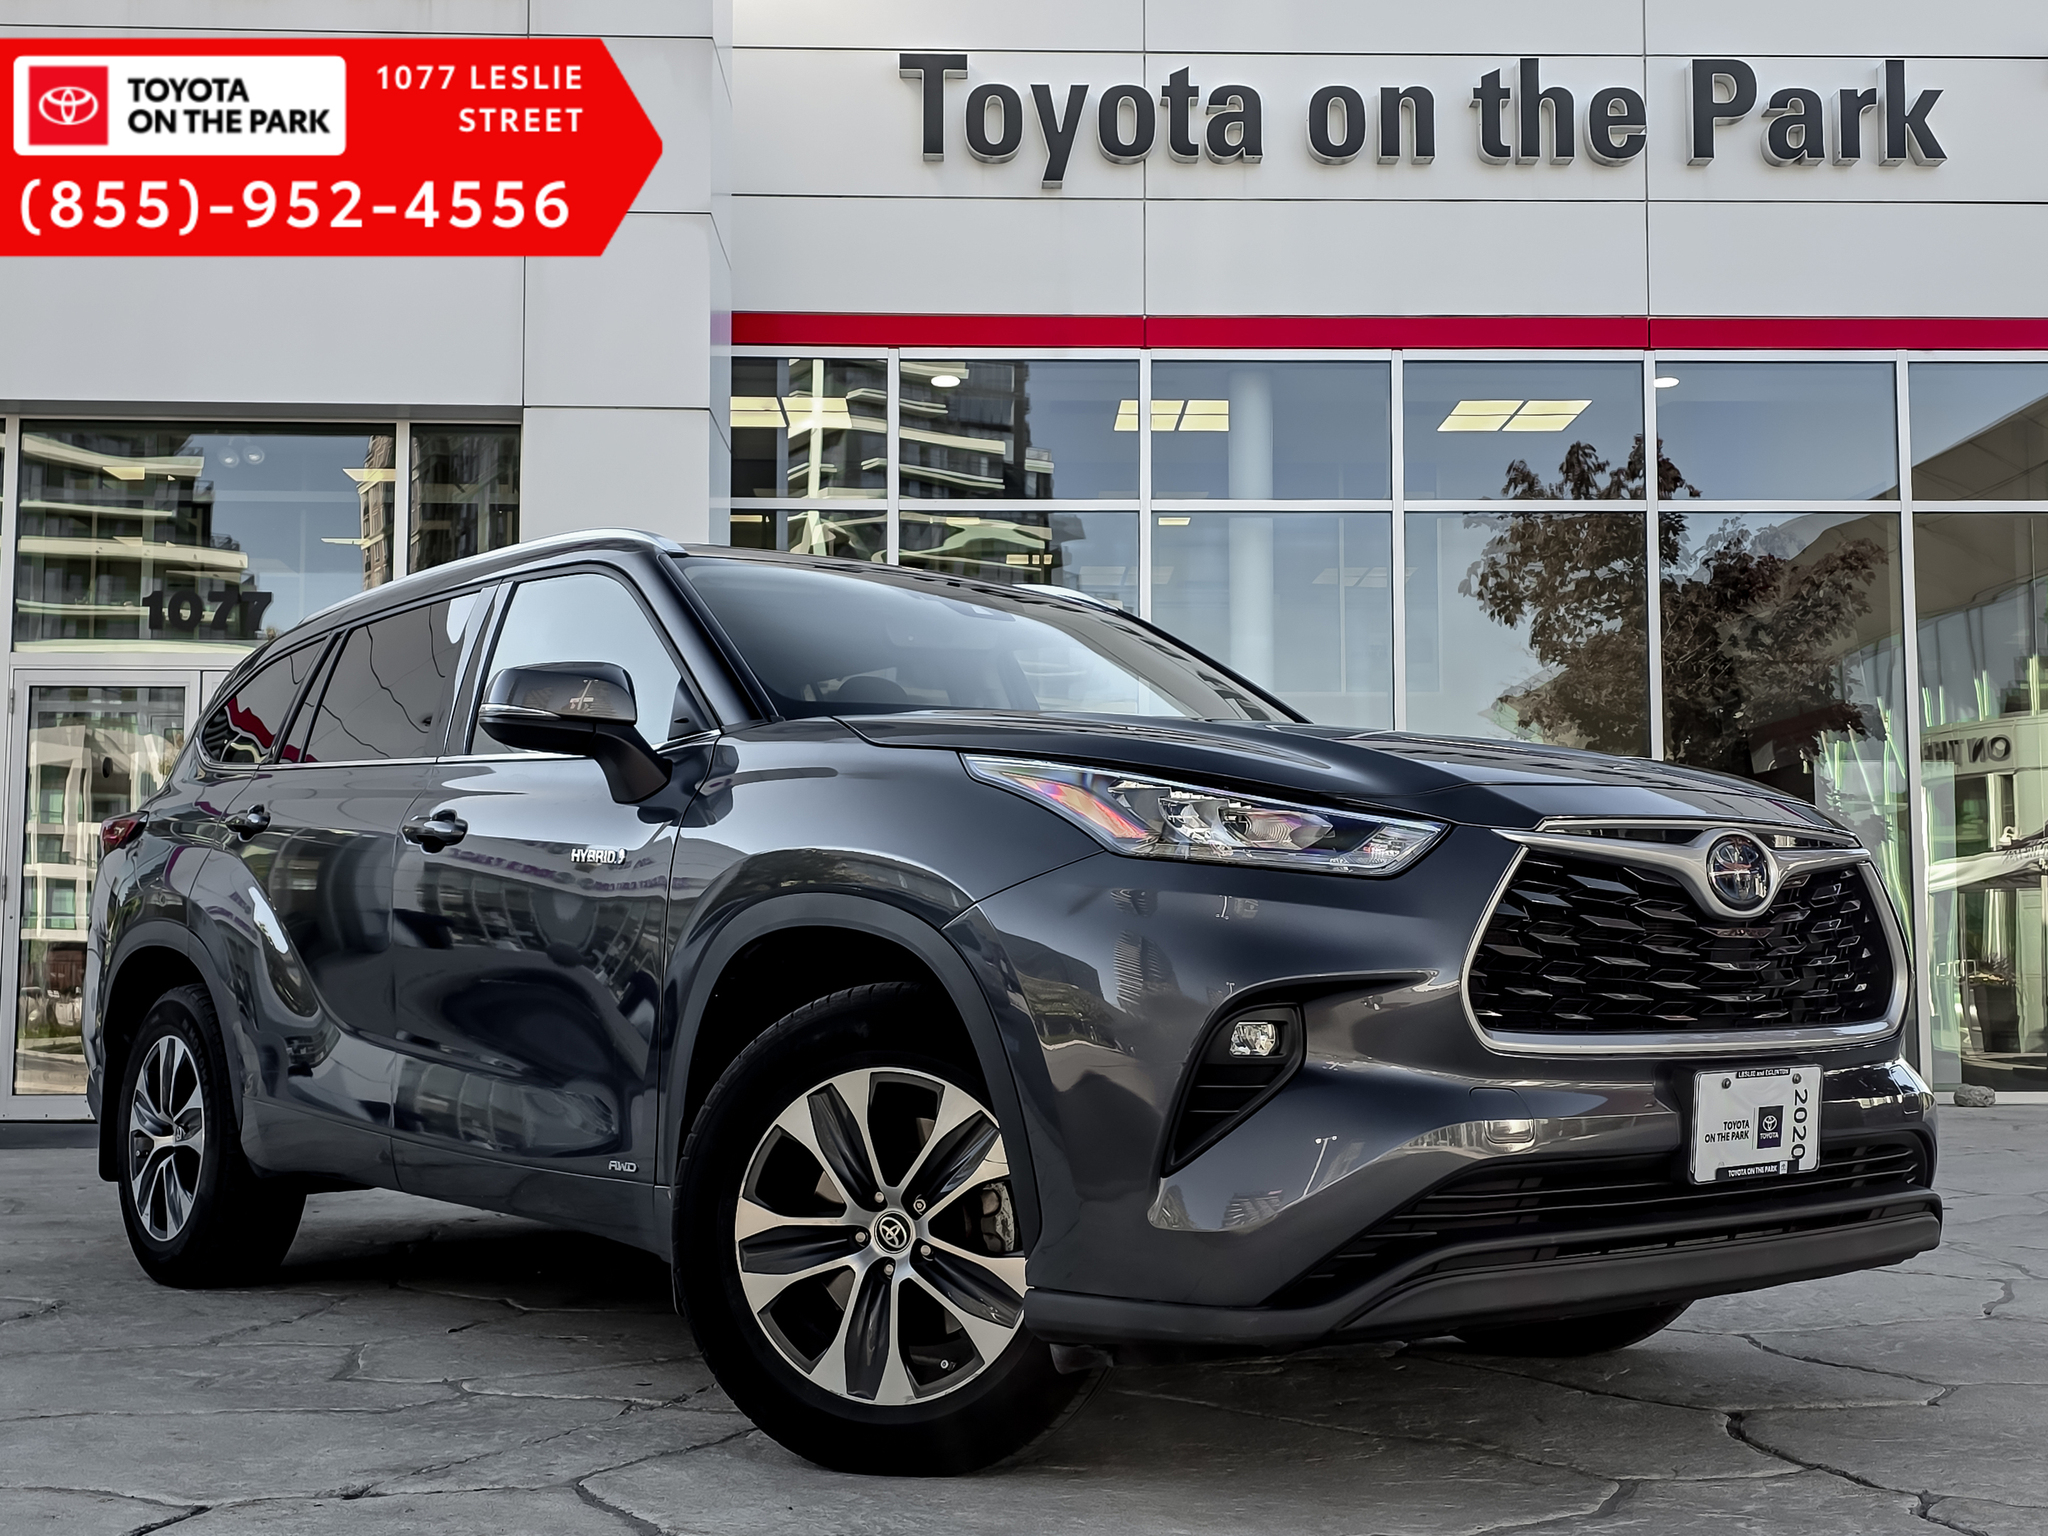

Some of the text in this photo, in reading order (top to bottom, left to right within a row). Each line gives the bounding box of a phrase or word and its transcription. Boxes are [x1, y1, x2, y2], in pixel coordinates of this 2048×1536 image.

[900, 53, 1948, 189] Toyota on the Park
[142, 590, 272, 631] 1077
[571, 848, 616, 864] HYBRID
[1723, 1119, 1750, 1131] TOYOTA
[1791, 1088, 1808, 1160] 2020
[1704, 1130, 1750, 1143] ON THE PARK
[1760, 1132, 1779, 1140] TOYOTA
[608, 1160, 637, 1173] AWD
[1727, 1167, 1747, 1178] TOYOTA
[1747, 1166, 1755, 1176] ON
[1755, 1165, 1764, 1175] THE
[1764, 1164, 1778, 1173] PARK
